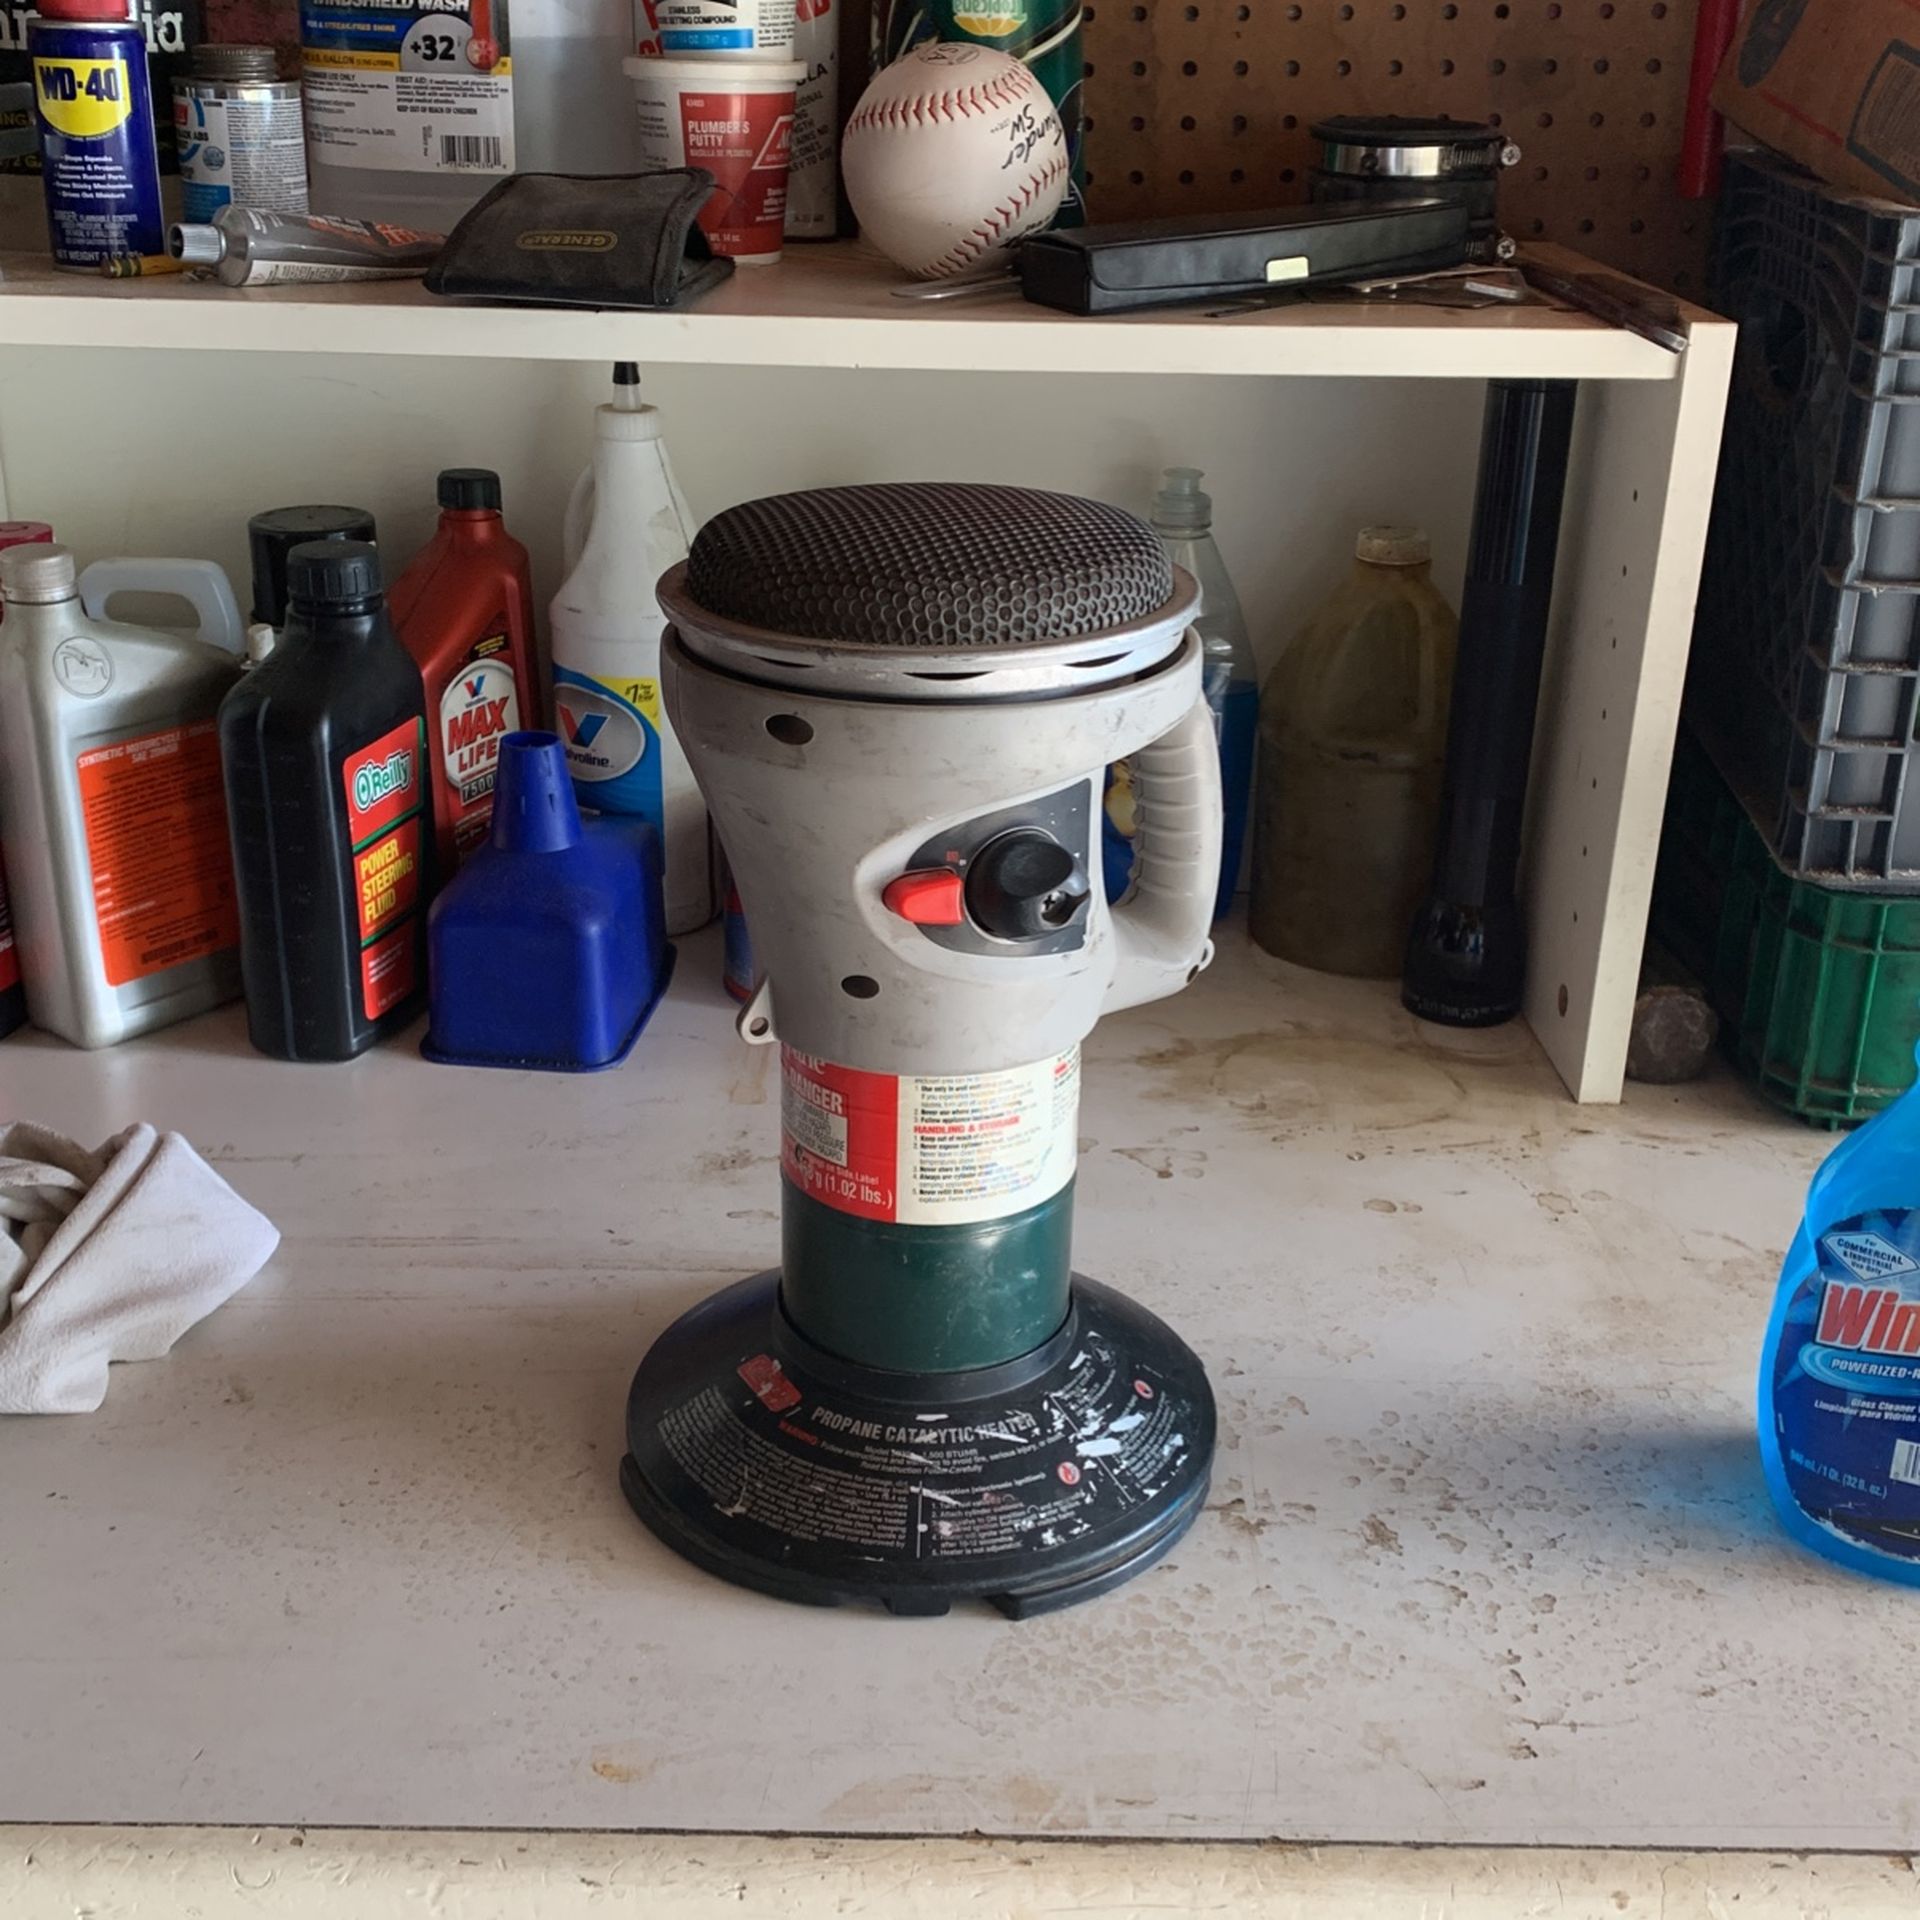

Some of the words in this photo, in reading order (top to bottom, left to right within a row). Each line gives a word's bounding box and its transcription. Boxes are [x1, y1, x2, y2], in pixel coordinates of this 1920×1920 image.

[410, 34, 456, 61] +32
[39, 66, 120, 102] WD-40
[340, 73, 355, 81] ONLY
[689, 133, 724, 147] PUTTY
[533, 235, 607, 247] GENERAL
[447, 695, 510, 756] MAX
[78, 746, 124, 769] SYNTHETIC
[125, 730, 180, 755] MOTORCYCLE
[458, 736, 498, 773] LIFE
[355, 751, 412, 810] O'Reilly
[359, 837, 399, 881] POWER
[362, 851, 414, 901] STEERING
[364, 886, 397, 925] FLUID
[789, 1068, 843, 1115] DANGER
[913, 1124, 965, 1135] HANDLING
[968, 1125, 975, 1133] &
[978, 1115, 1020, 1131] STORAGE
[824, 1172, 857, 1200] (1.02
[860, 1183, 893, 1210] lbs.)
[855, 1171, 880, 1186] Label
[1836, 1237, 1904, 1266] COMMERCIAL
[1849, 1251, 1893, 1271] INDUSTRIAL
[1851, 1261, 1864, 1270] Use
[1865, 1265, 1883, 1275] Only
[1813, 1399, 1859, 1416] Limpiador
[1859, 1409, 1883, 1419] para
[1883, 1412, 1917, 1422] Vidrios
[1850, 1398, 1877, 1410] Glass
[1877, 1401, 1916, 1413] Cleaner
[811, 1405, 883, 1441] PROPANE
[884, 1423, 976, 1444] CATALYTIC
[844, 1450, 889, 1463] instructions
[952, 1457, 973, 1467] avoid
[860, 1460, 881, 1471] Read
[881, 1463, 922, 1475] Instruction
[1841, 1472, 1858, 1488] (32
